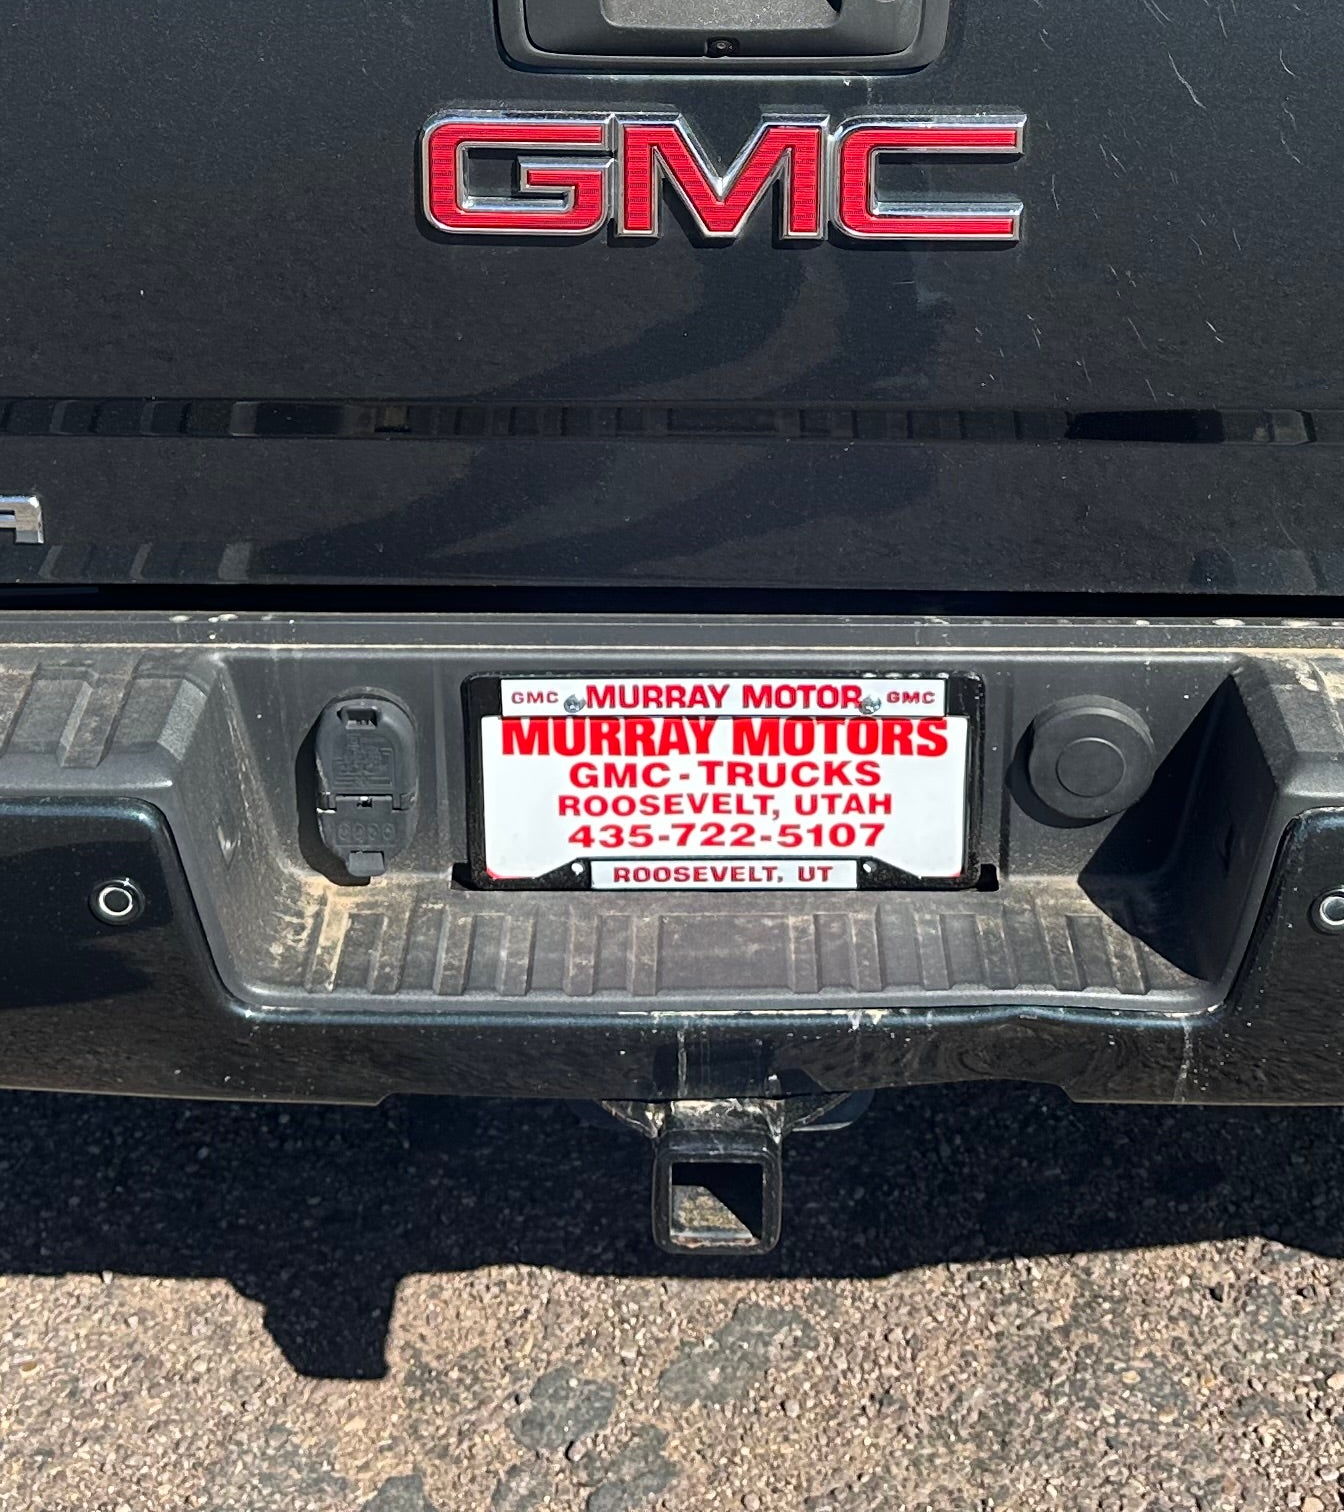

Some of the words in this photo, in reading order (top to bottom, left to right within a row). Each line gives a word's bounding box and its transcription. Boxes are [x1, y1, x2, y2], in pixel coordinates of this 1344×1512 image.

[421, 109, 1027, 241] GMC
[511, 691, 559, 705] GMC
[586, 684, 730, 709] MURRAY
[742, 684, 863, 710] MOTOR
[886, 691, 936, 705] GMC
[501, 716, 720, 757] MURRAY
[732, 716, 949, 758] MOTORS
[558, 793, 781, 821] ROOSEVELT,
[794, 793, 892, 816] UTAH
[568, 822, 886, 849] 435-722-5107
[612, 865, 784, 884] ROOSEVELT,
[798, 865, 834, 883] UT
